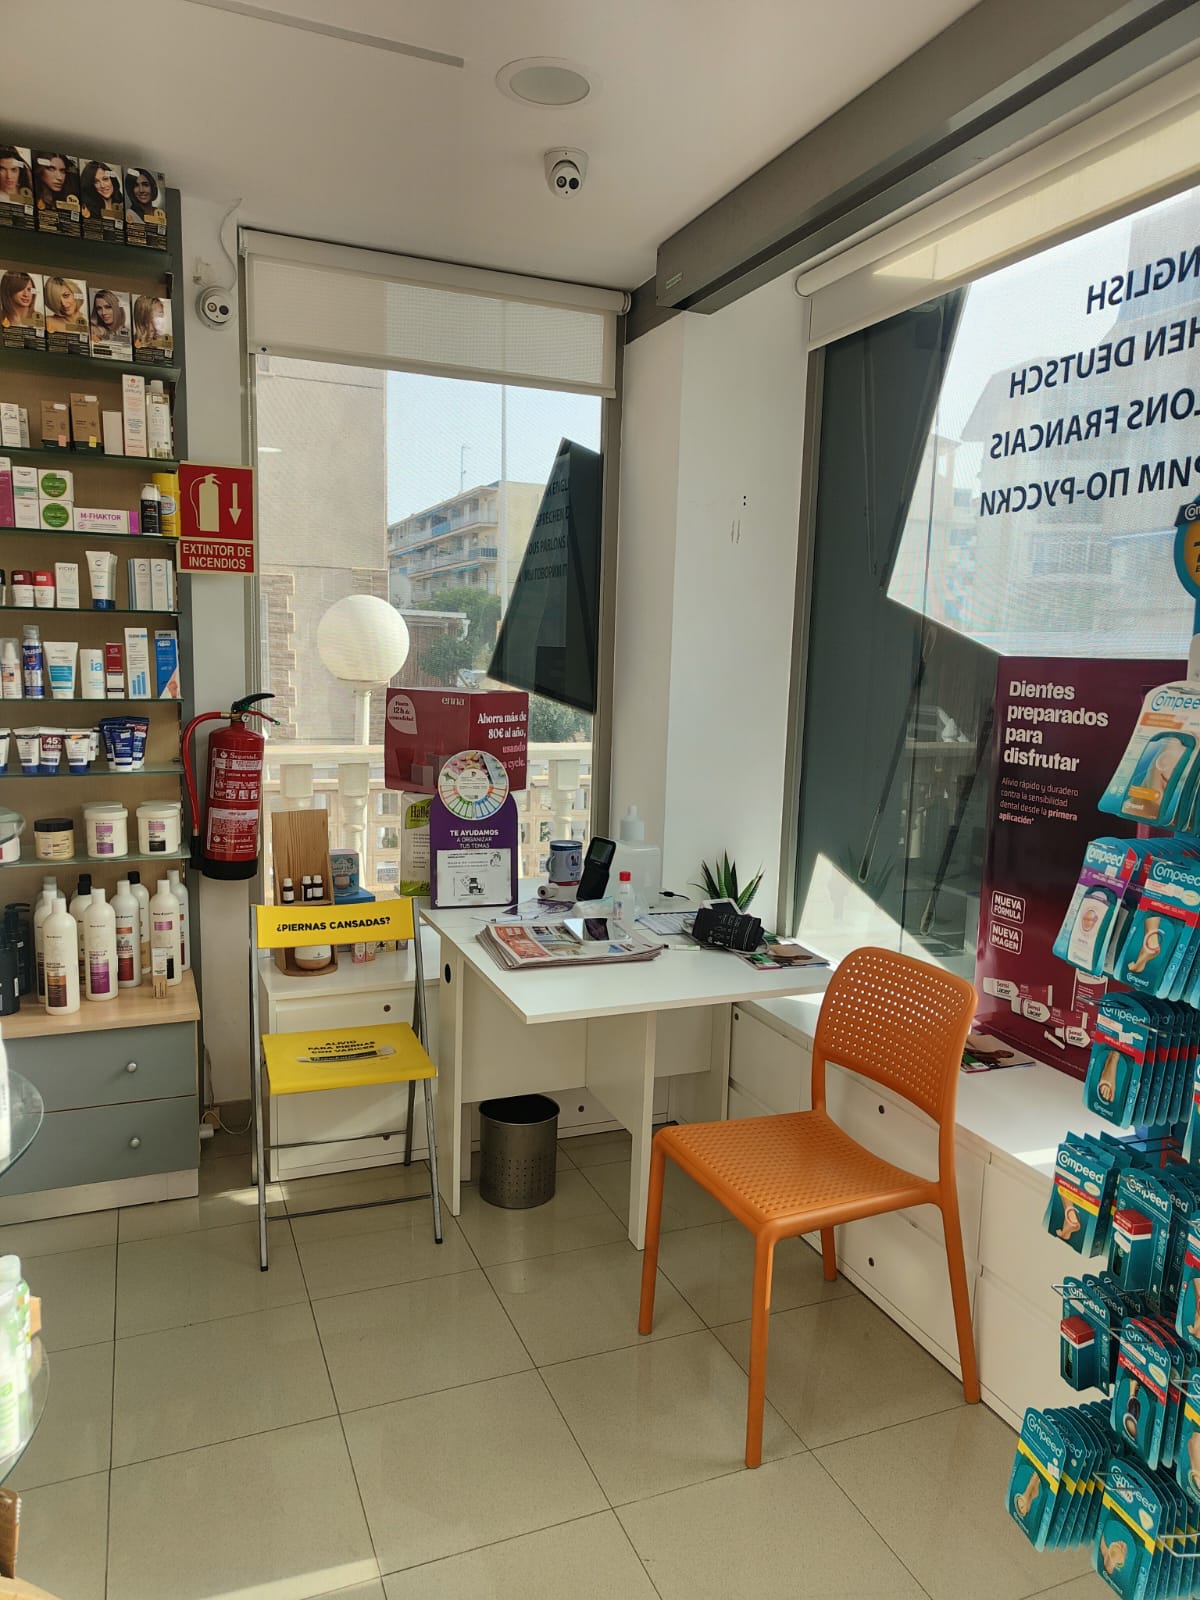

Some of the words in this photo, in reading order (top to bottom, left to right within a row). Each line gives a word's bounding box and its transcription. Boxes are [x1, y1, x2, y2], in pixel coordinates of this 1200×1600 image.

[182, 543, 233, 557] EXTINTOR
[236, 547, 252, 557] DE
[188, 557, 246, 570] INCENDIOS
[1009, 679, 1076, 700] Dientes
[441, 697, 465, 706] enna
[477, 713, 504, 725] Ahorra
[504, 711, 518, 722] más
[519, 713, 527, 721] de
[1007, 705, 1110, 728] preparados
[488, 729, 504, 740] 80€
[504, 728, 511, 738] al
[1005, 727, 1043, 745] para
[502, 743, 526, 754] usando
[1003, 747, 1081, 772] disfrutar
[1001, 777, 1018, 787] Alivio
[1019, 781, 1041, 792] rápido
[1047, 784, 1079, 797] duradero
[1000, 789, 1021, 799] contra
[1021, 791, 1029, 800] la
[1028, 794, 1068, 807] sensibilidad
[1000, 800, 1020, 811] dental
[1020, 804, 1041, 814] desde
[1041, 806, 1049, 816] la
[1048, 808, 1079, 822] primera
[460, 829, 499, 837] AYUDAMOS
[994, 894, 1022, 911] NUEVA
[277, 922, 327, 933] ¿PIERNAS
[329, 916, 391, 930] CANSADAS?
[992, 925, 1019, 942] NUEVA
[991, 934, 1019, 951] IMAGEN
[1058, 1150, 1104, 1185] Compeed
[1126, 1174, 1169, 1211] Compeed
[1026, 1413, 1063, 1457] Compeed
